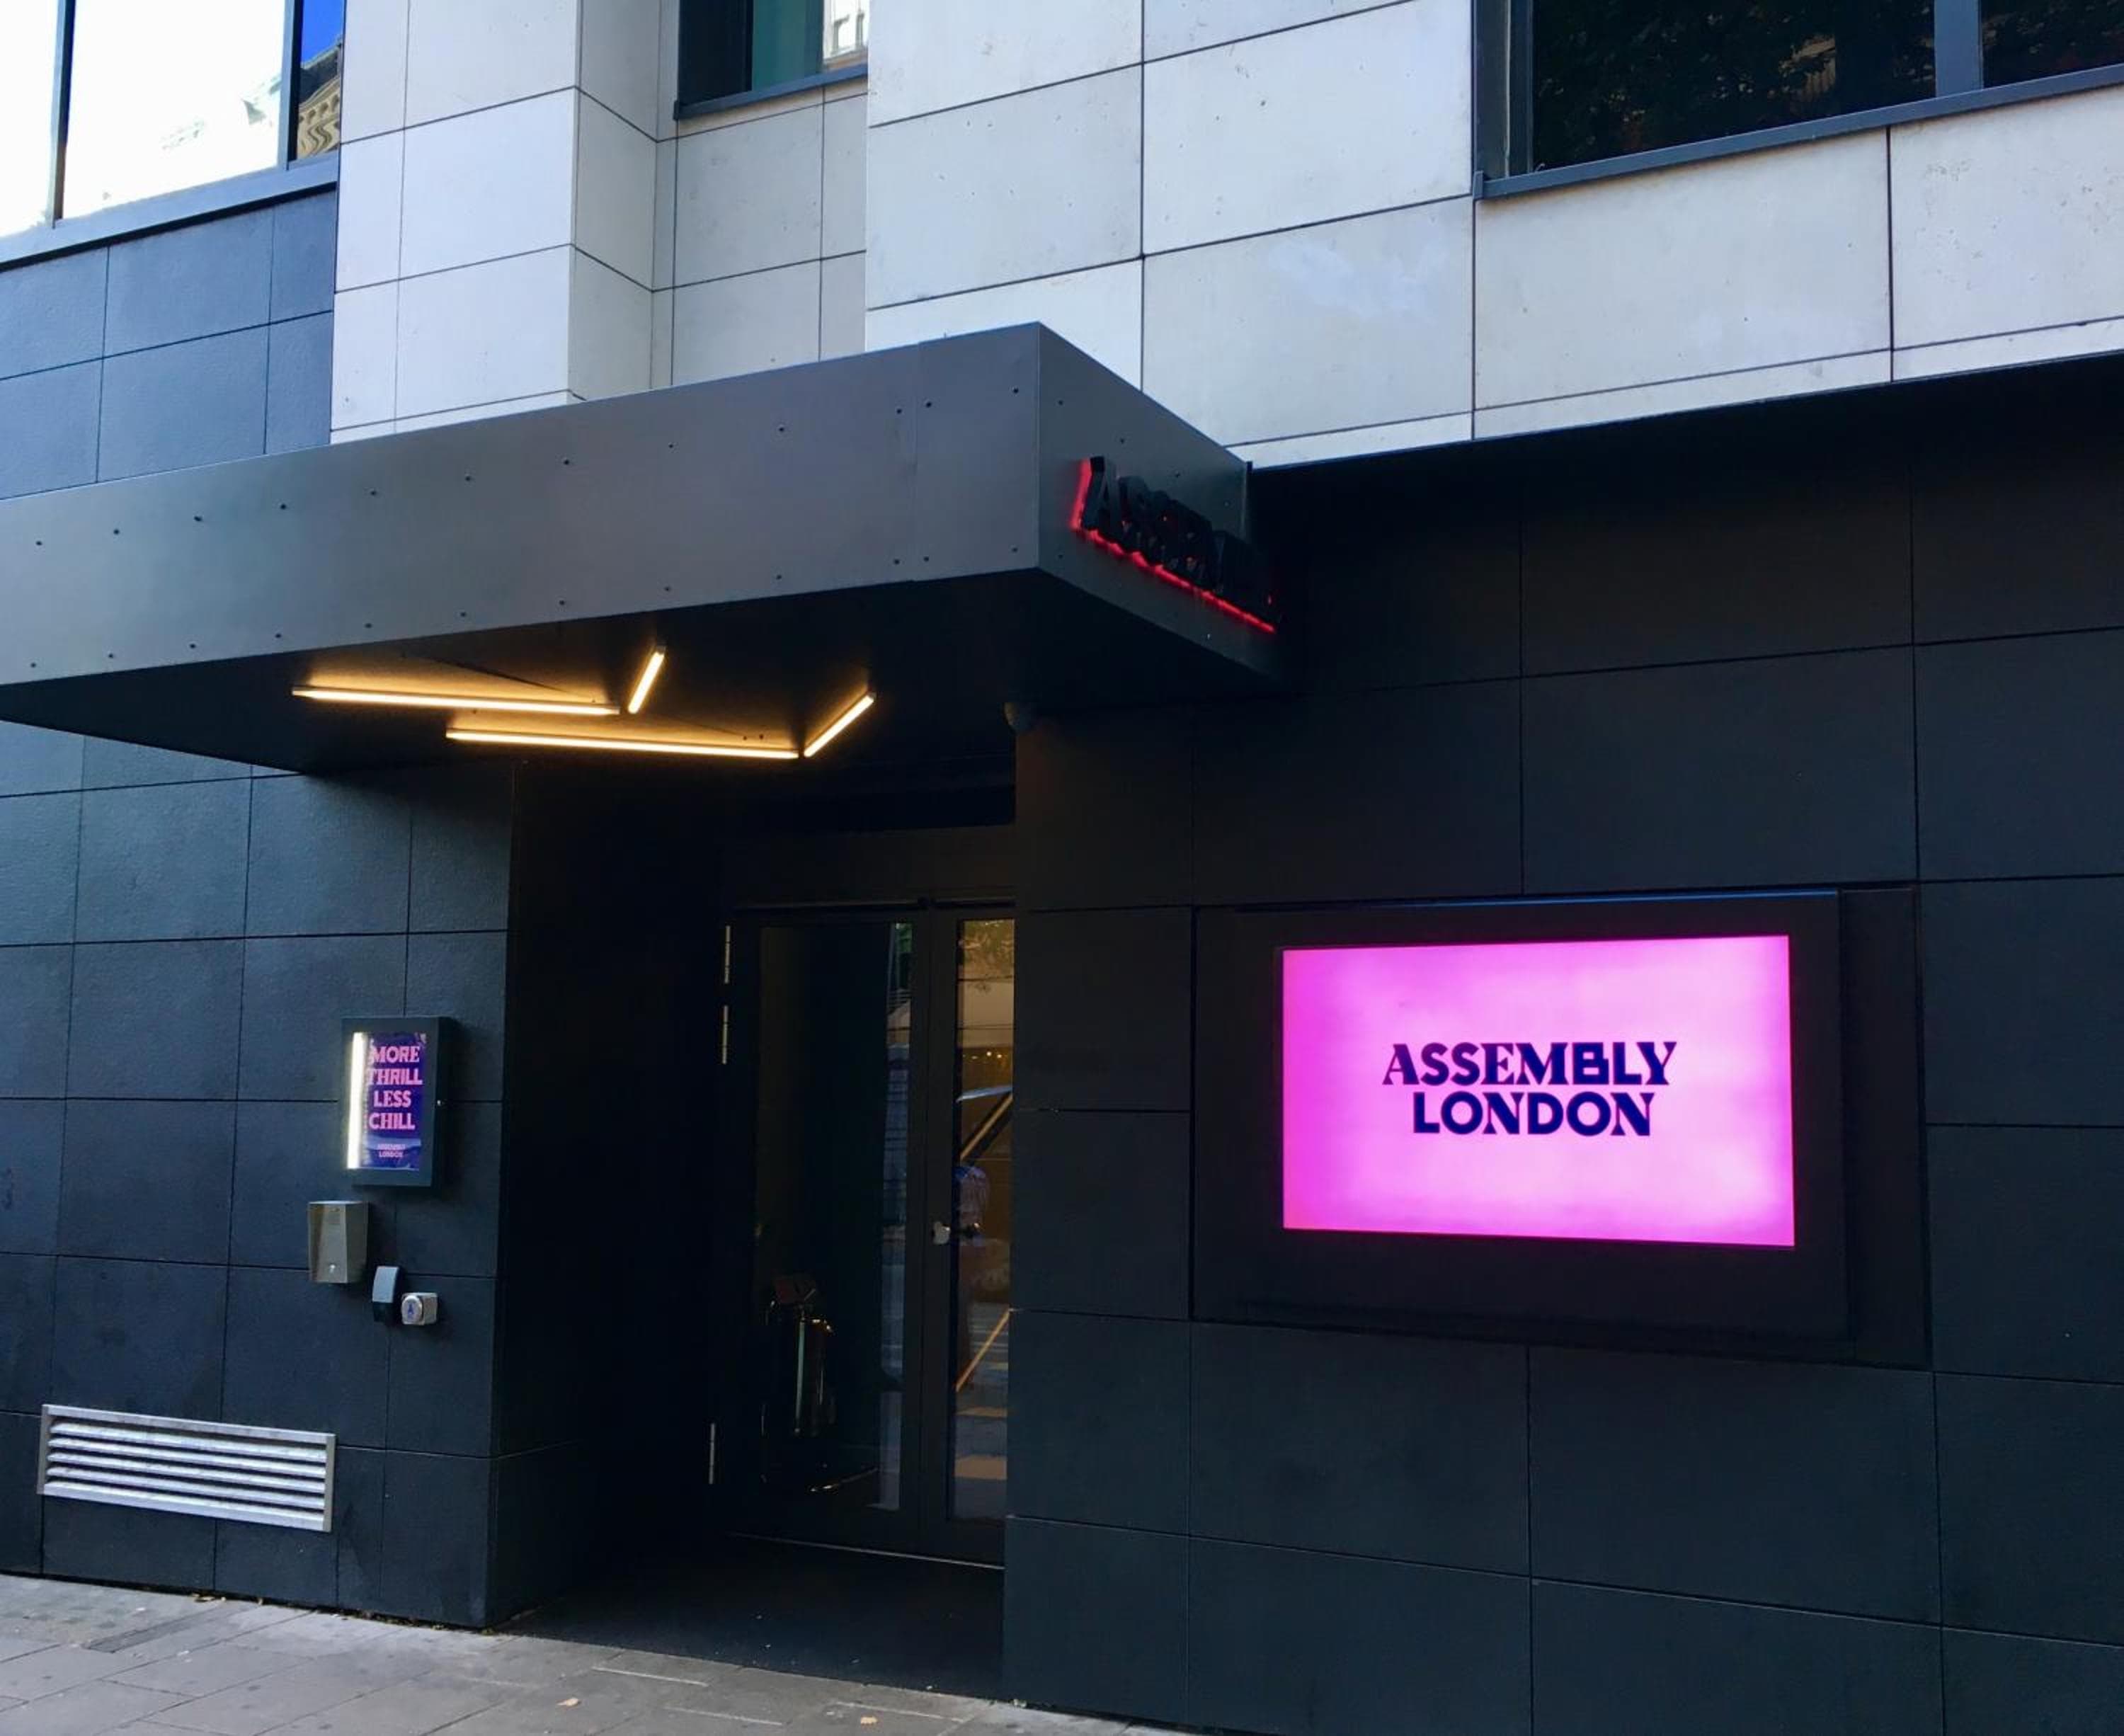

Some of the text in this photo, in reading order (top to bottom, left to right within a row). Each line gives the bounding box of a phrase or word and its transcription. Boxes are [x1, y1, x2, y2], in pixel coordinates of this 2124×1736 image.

[370, 1045, 421, 1063] MORE
[1382, 1041, 1677, 1086] ASSEMBLY
[367, 1068, 423, 1085] THRILL
[373, 1090, 412, 1108] LESS
[368, 1112, 416, 1130] CHILL
[1413, 1091, 1655, 1136] LONDON
